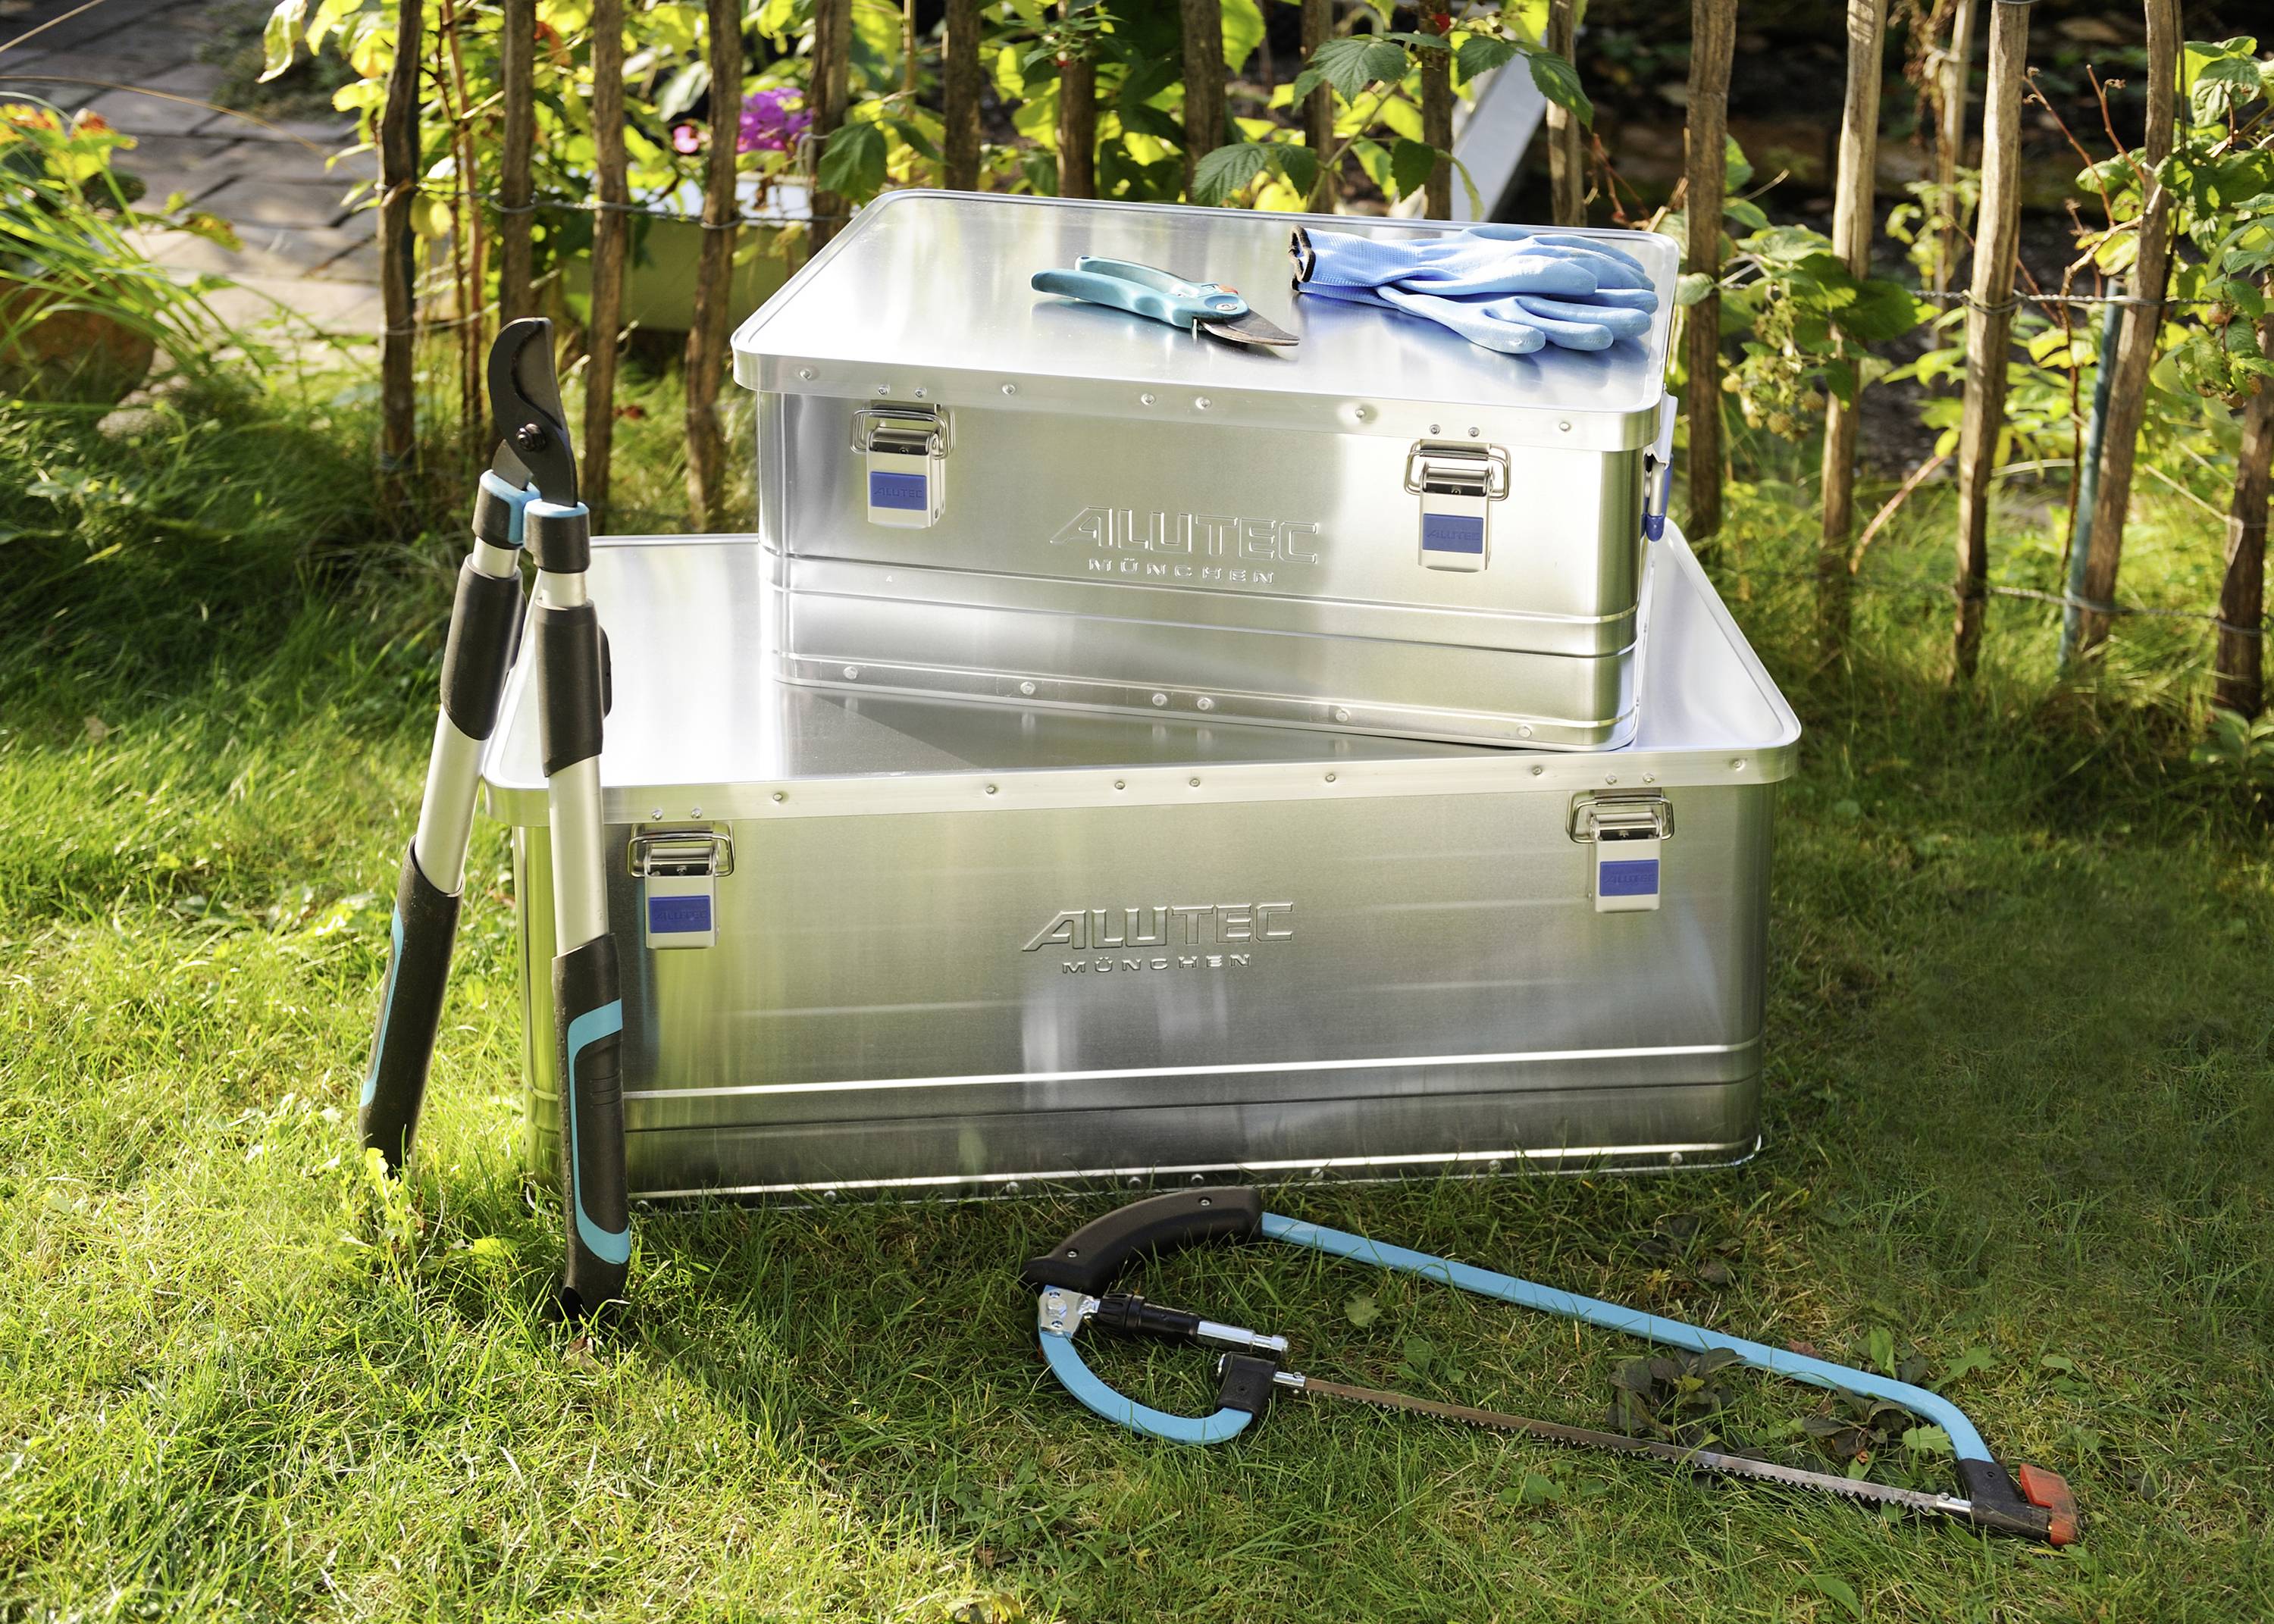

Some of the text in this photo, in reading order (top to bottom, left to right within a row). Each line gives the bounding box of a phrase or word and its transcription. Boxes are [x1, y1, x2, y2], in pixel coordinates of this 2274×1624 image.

[873, 487, 922, 498] ALUTEC
[1050, 506, 1320, 564] ALUTEC
[1088, 558, 1274, 584] MÜNCHEN
[1022, 902, 1293, 952] ALUTEC
[1061, 953, 1251, 974] MÜNCHEN
